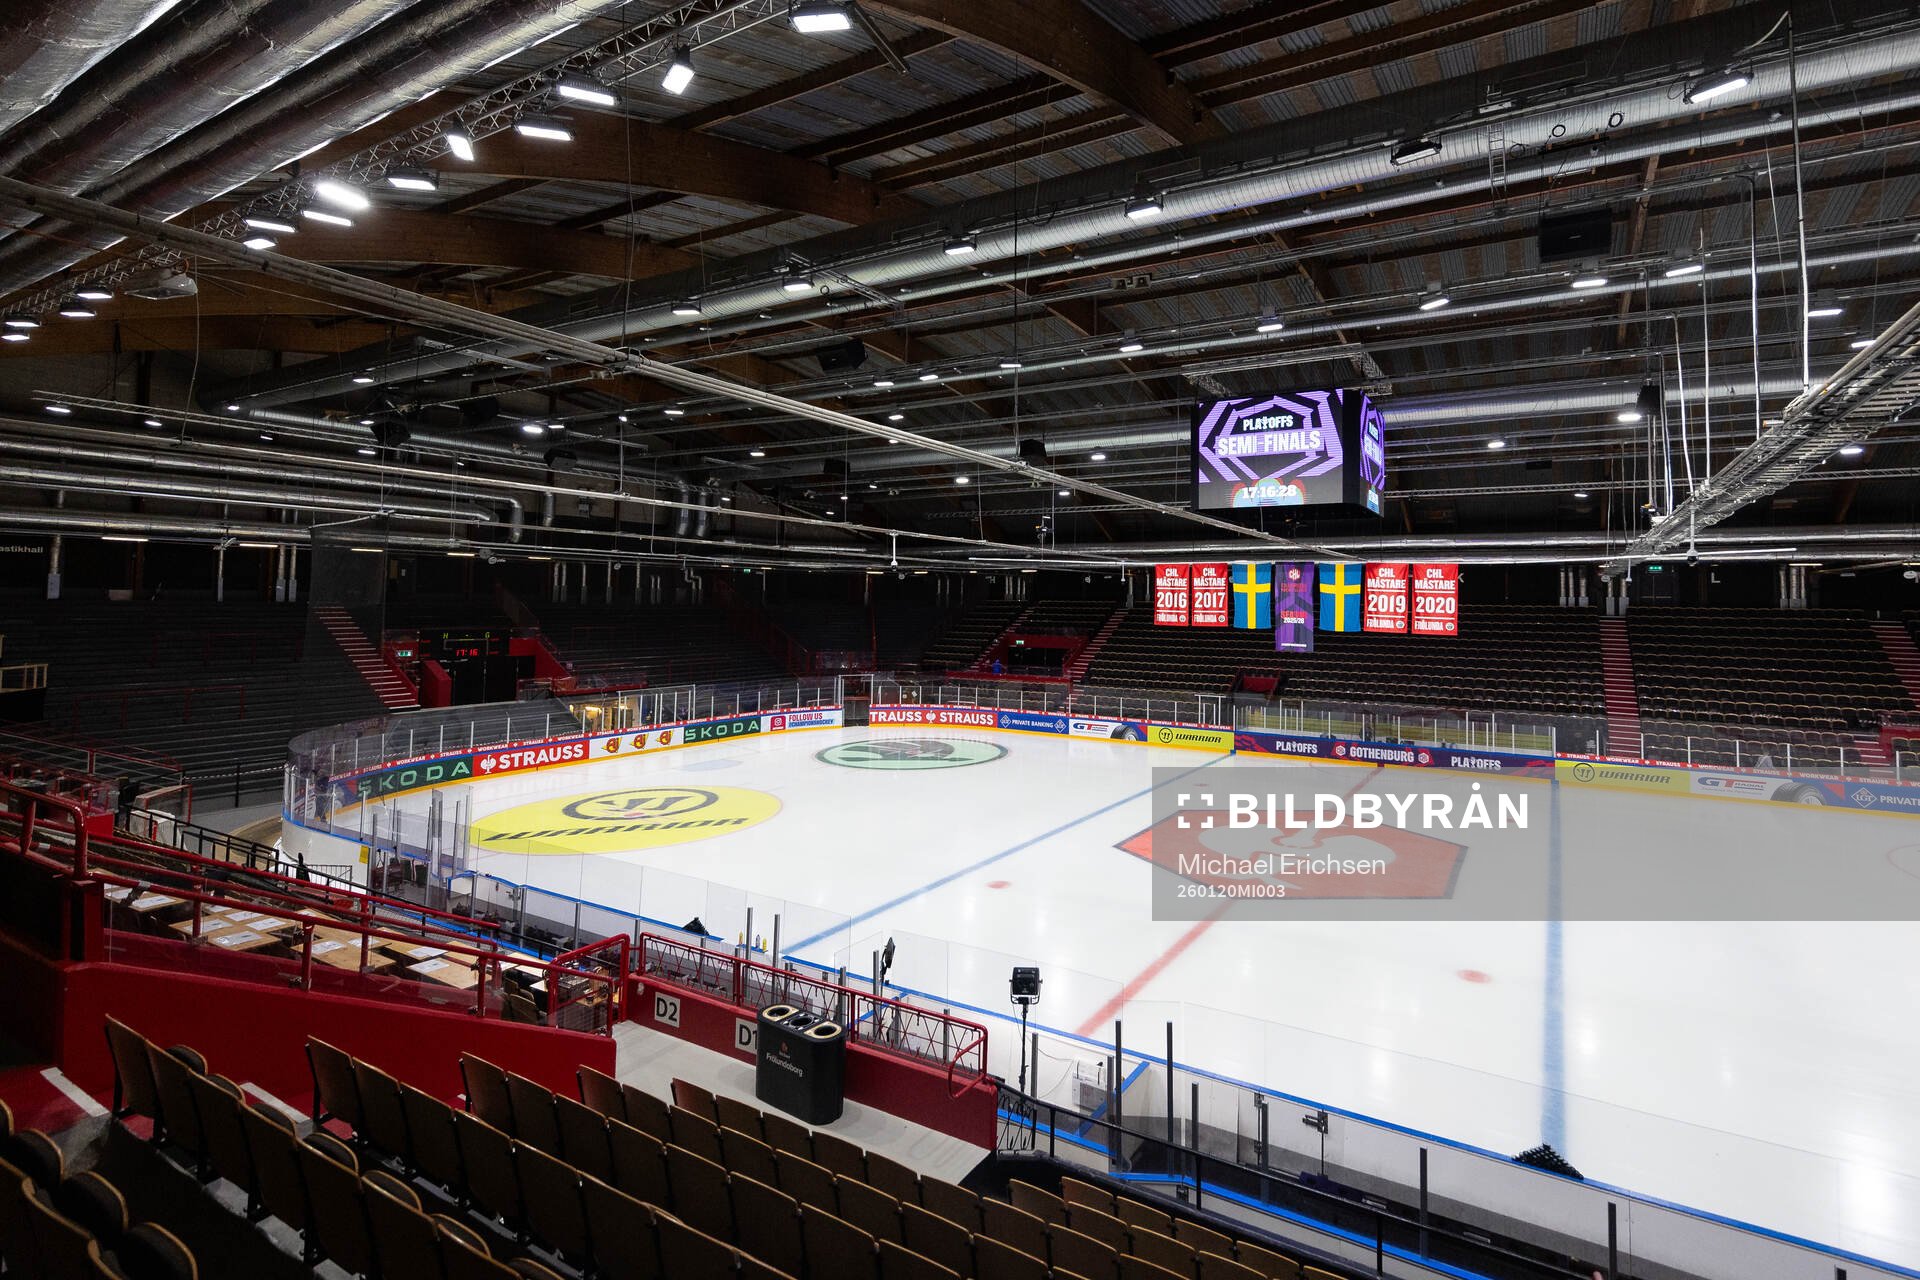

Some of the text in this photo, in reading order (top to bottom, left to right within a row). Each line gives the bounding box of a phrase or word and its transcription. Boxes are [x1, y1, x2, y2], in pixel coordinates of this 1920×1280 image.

[1243, 415, 1293, 431] PLAYOFFS
[1218, 430, 1321, 456] SEMI-FINALS
[1165, 568, 1179, 576] CHL
[1203, 568, 1216, 576] CHL
[1289, 569, 1300, 580] CHL
[1379, 568, 1395, 577] CHL
[1427, 569, 1444, 578] CHL
[1157, 592, 1187, 608] 2016
[1195, 592, 1226, 608] 2017
[1368, 594, 1406, 612] 2019
[1416, 597, 1455, 614] 2020
[789, 713, 813, 721] FOLLOW
[940, 713, 993, 725] STRAUSS
[478, 743, 508, 752] WORKWEAR
[1276, 741, 1317, 753] PLAYOFFS
[499, 744, 584, 769] STRAUSS
[1350, 747, 1414, 762] GOTHENBURG
[1451, 756, 1501, 770] PLAYOFFS
[1600, 770, 1670, 784] WARRIOR
[1698, 777, 1734, 787] GT
[482, 817, 749, 842] WARRIOR
[657, 993, 677, 1021] D2
[739, 1024, 757, 1049] D1
[766, 1052, 802, 1077] Frölundaborg
